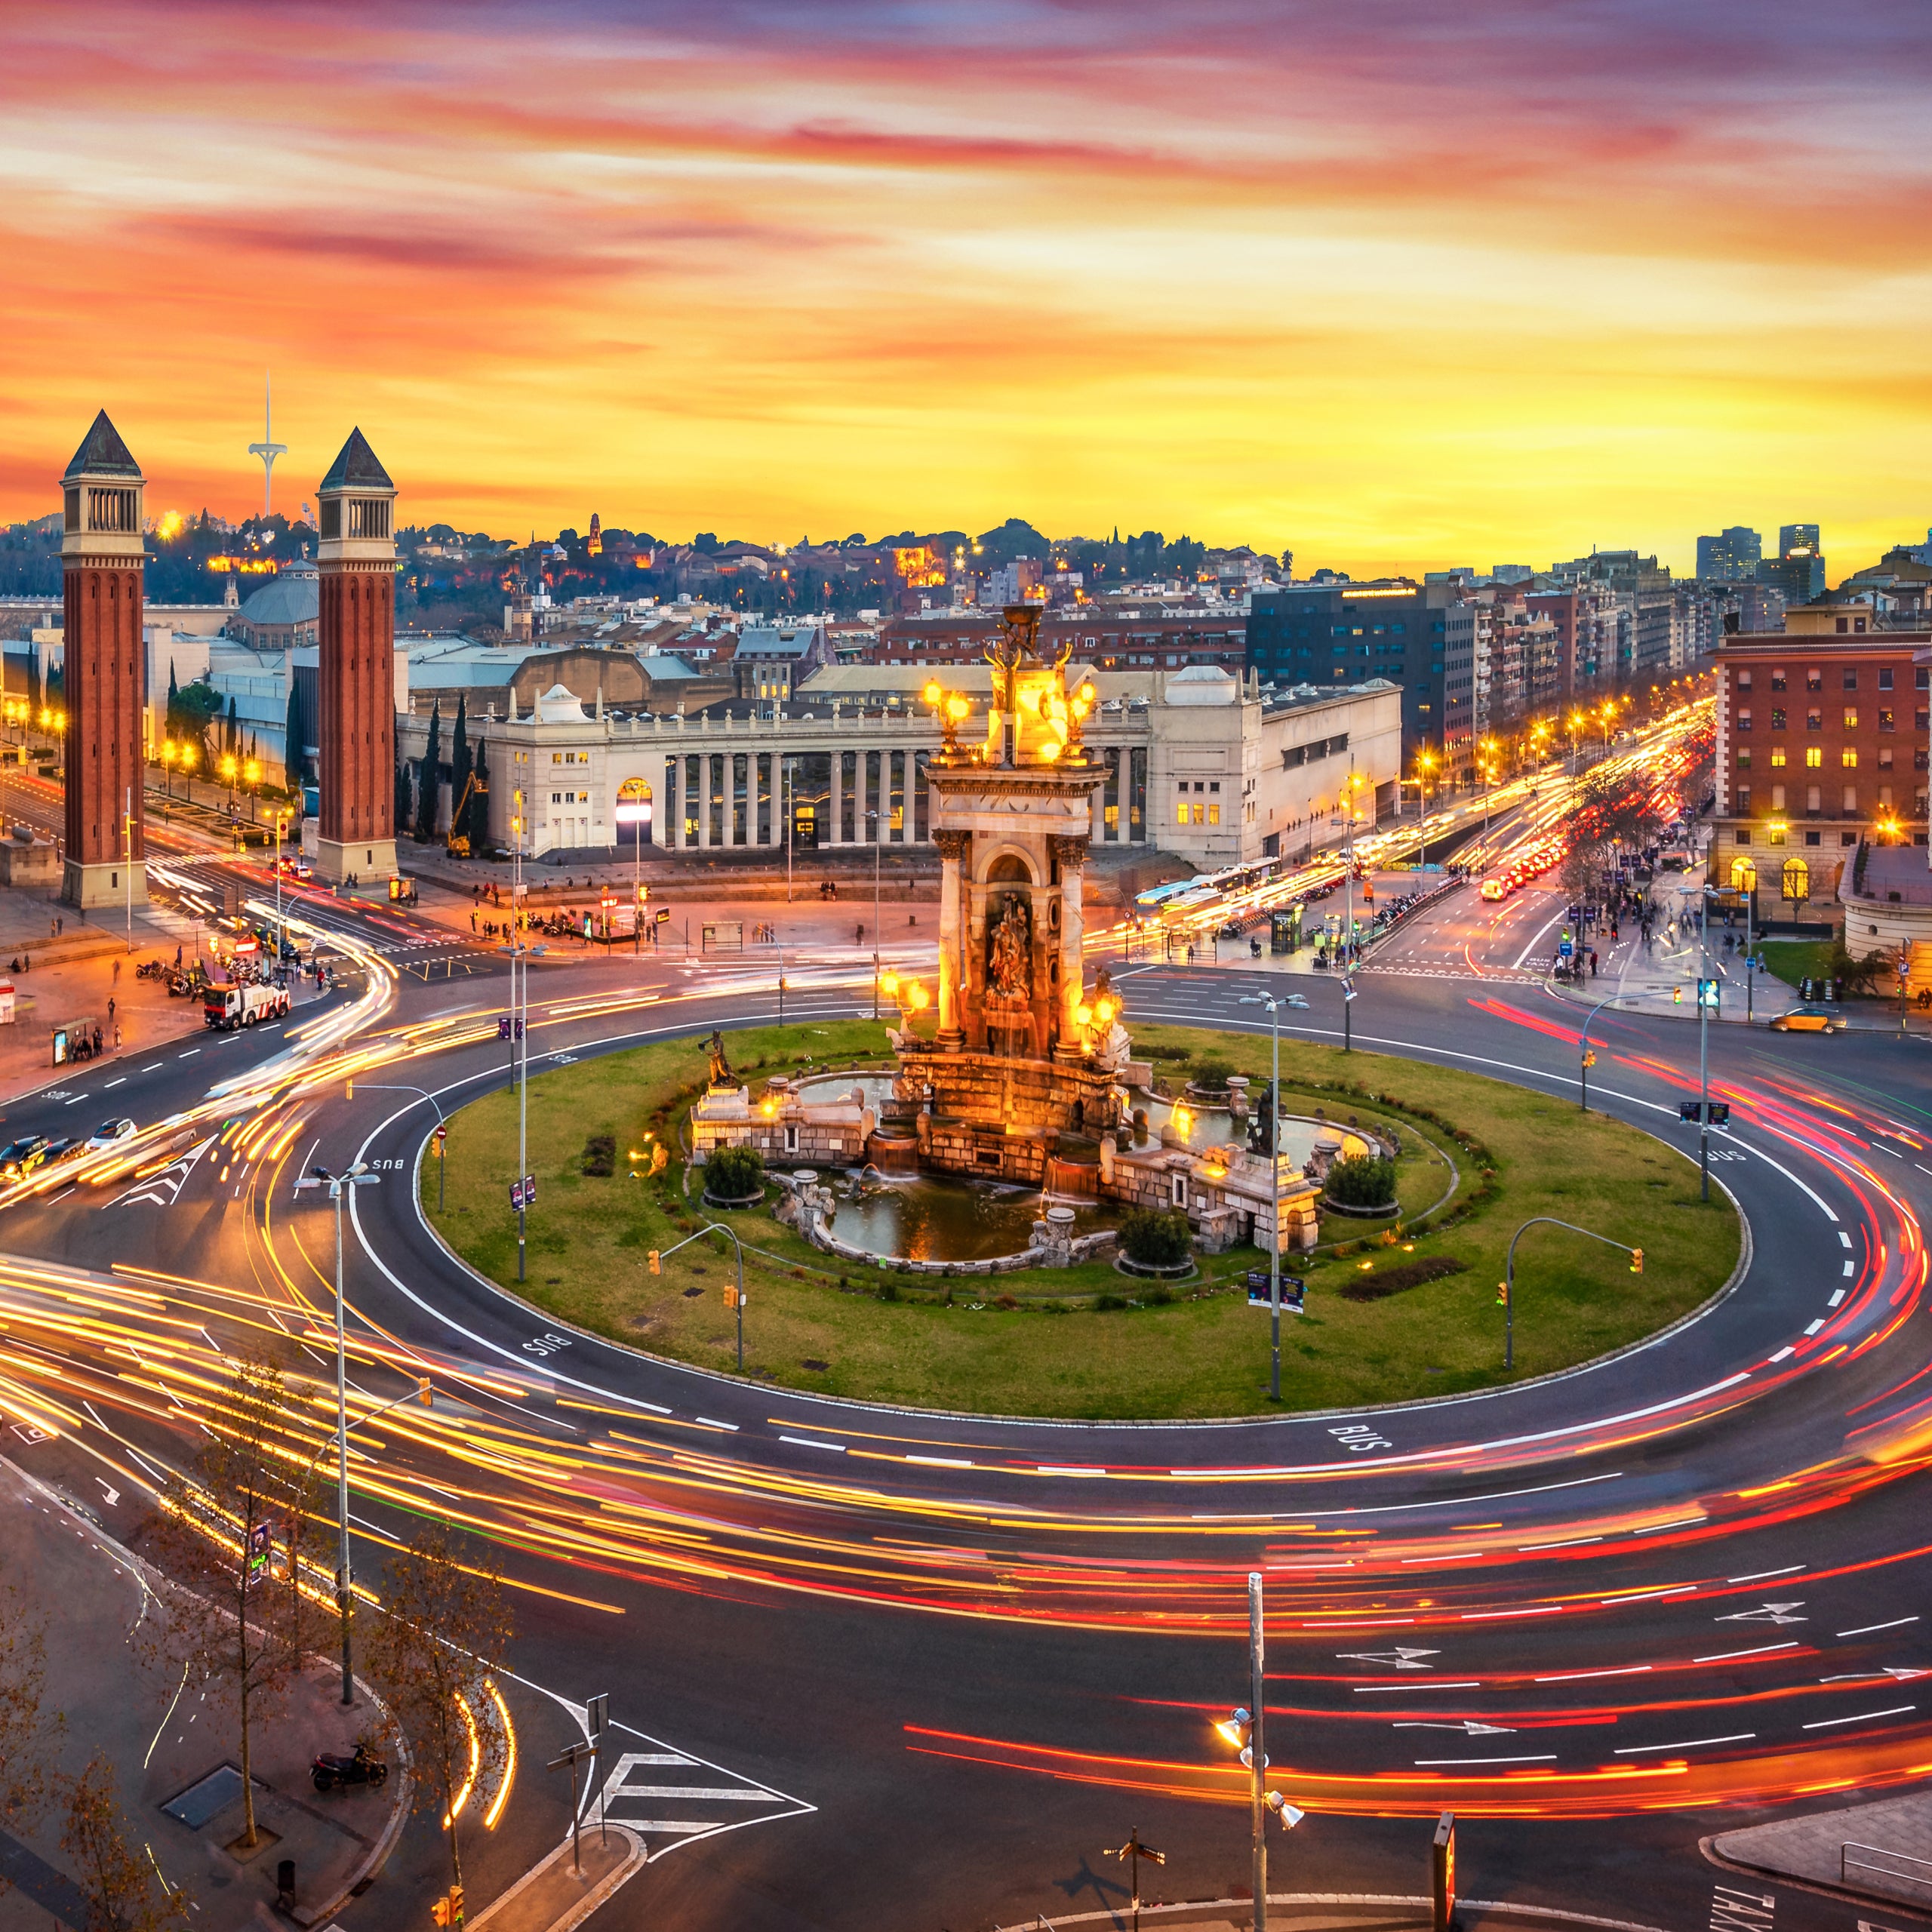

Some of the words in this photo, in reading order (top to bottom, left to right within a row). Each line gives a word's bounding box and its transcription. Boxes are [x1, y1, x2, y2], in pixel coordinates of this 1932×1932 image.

[1697, 1150, 1747, 1161] BUS
[371, 1159, 405, 1170] BUS
[521, 1333, 572, 1356] BUS
[1327, 1424, 1393, 1451] BUS
